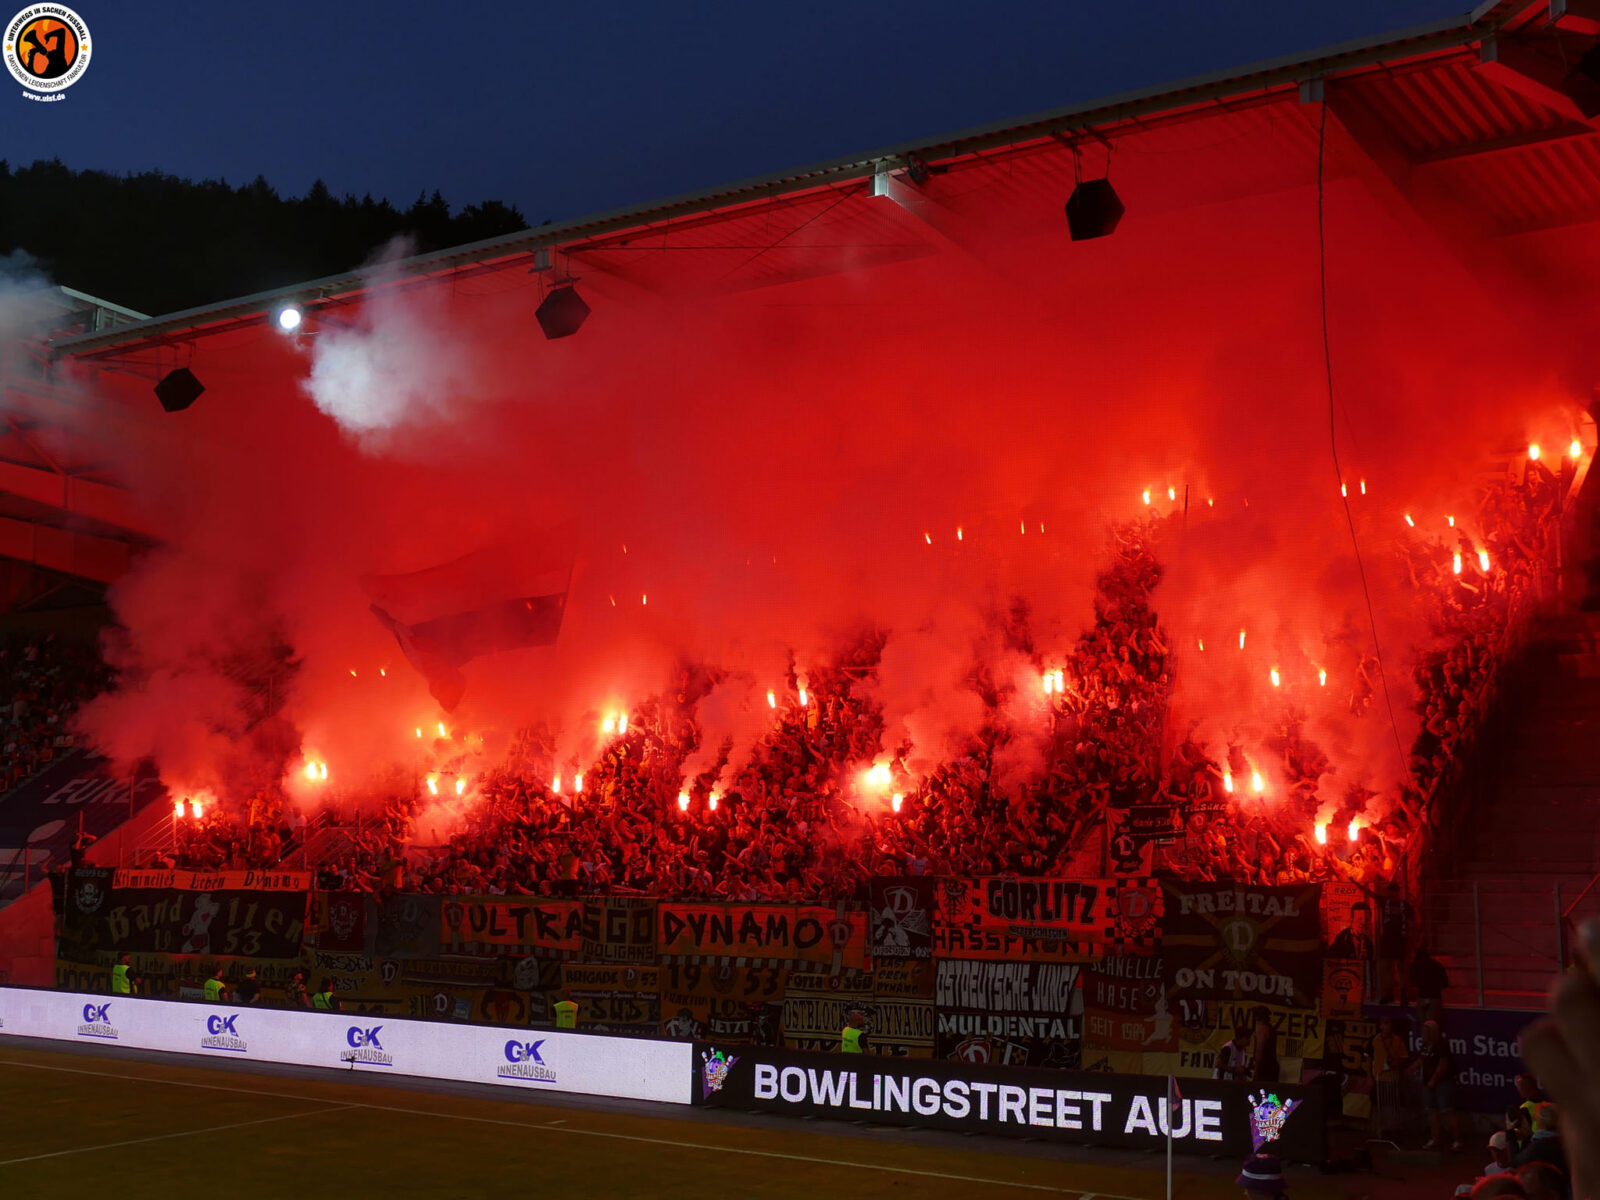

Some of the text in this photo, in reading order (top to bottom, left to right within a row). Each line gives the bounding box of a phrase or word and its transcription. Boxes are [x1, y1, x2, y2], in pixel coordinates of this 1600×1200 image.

[1180, 889, 1301, 917] FREITAL
[663, 910, 825, 949] DYNAMO
[1097, 981, 1139, 1010] HASE
[1175, 967, 1295, 998] ON TOUR
[77, 1024, 119, 1037] INNENAUSBAU
[873, 1005, 933, 1037] DYNAMO
[937, 1013, 1080, 1040] MULDENTAL
[1090, 1015, 1116, 1038] SEIT
[201, 1036, 247, 1050] INNENAUSBAU
[340, 1049, 393, 1064] INNENAUSBAU
[497, 1064, 557, 1080] INNENAUSBAU
[754, 1063, 1224, 1142] BOWLINGSTREET AUE
